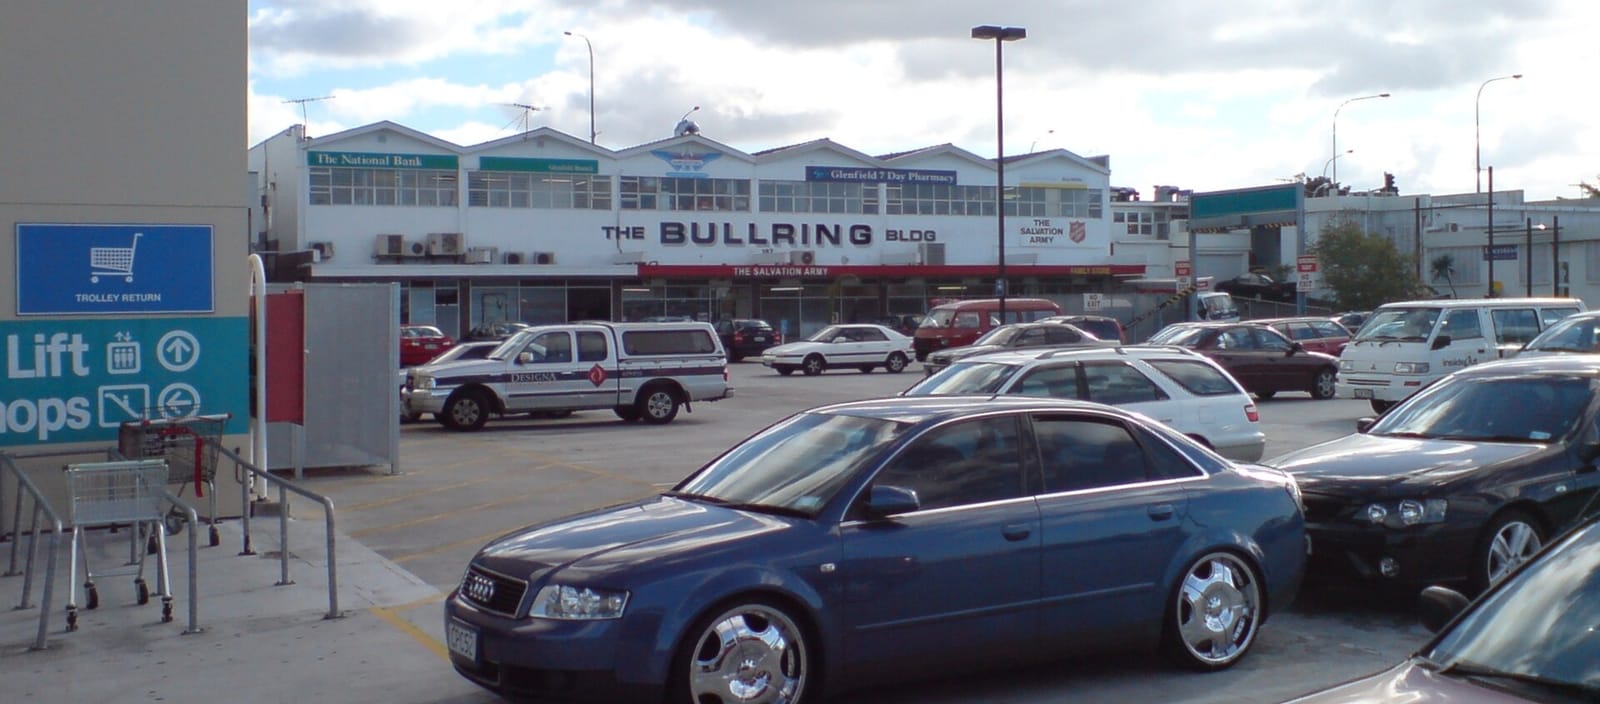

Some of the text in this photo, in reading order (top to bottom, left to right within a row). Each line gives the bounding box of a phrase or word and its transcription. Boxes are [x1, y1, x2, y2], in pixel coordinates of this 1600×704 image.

[317, 153, 423, 167] The National Bank
[830, 169, 954, 184] Glenfield 7 Day Pharmacy
[1033, 219, 1051, 227] THE
[601, 221, 937, 247] THE BULLRING BLDG
[1020, 227, 1064, 236] SALVATION
[1029, 236, 1054, 244] ARMY
[734, 267, 828, 276] THE SALVATION ARMY
[75, 293, 161, 303] TROLLEY RETURN
[7, 332, 90, 379] Lift
[511, 373, 557, 383] DESIGNA
[0, 396, 91, 440] ops
